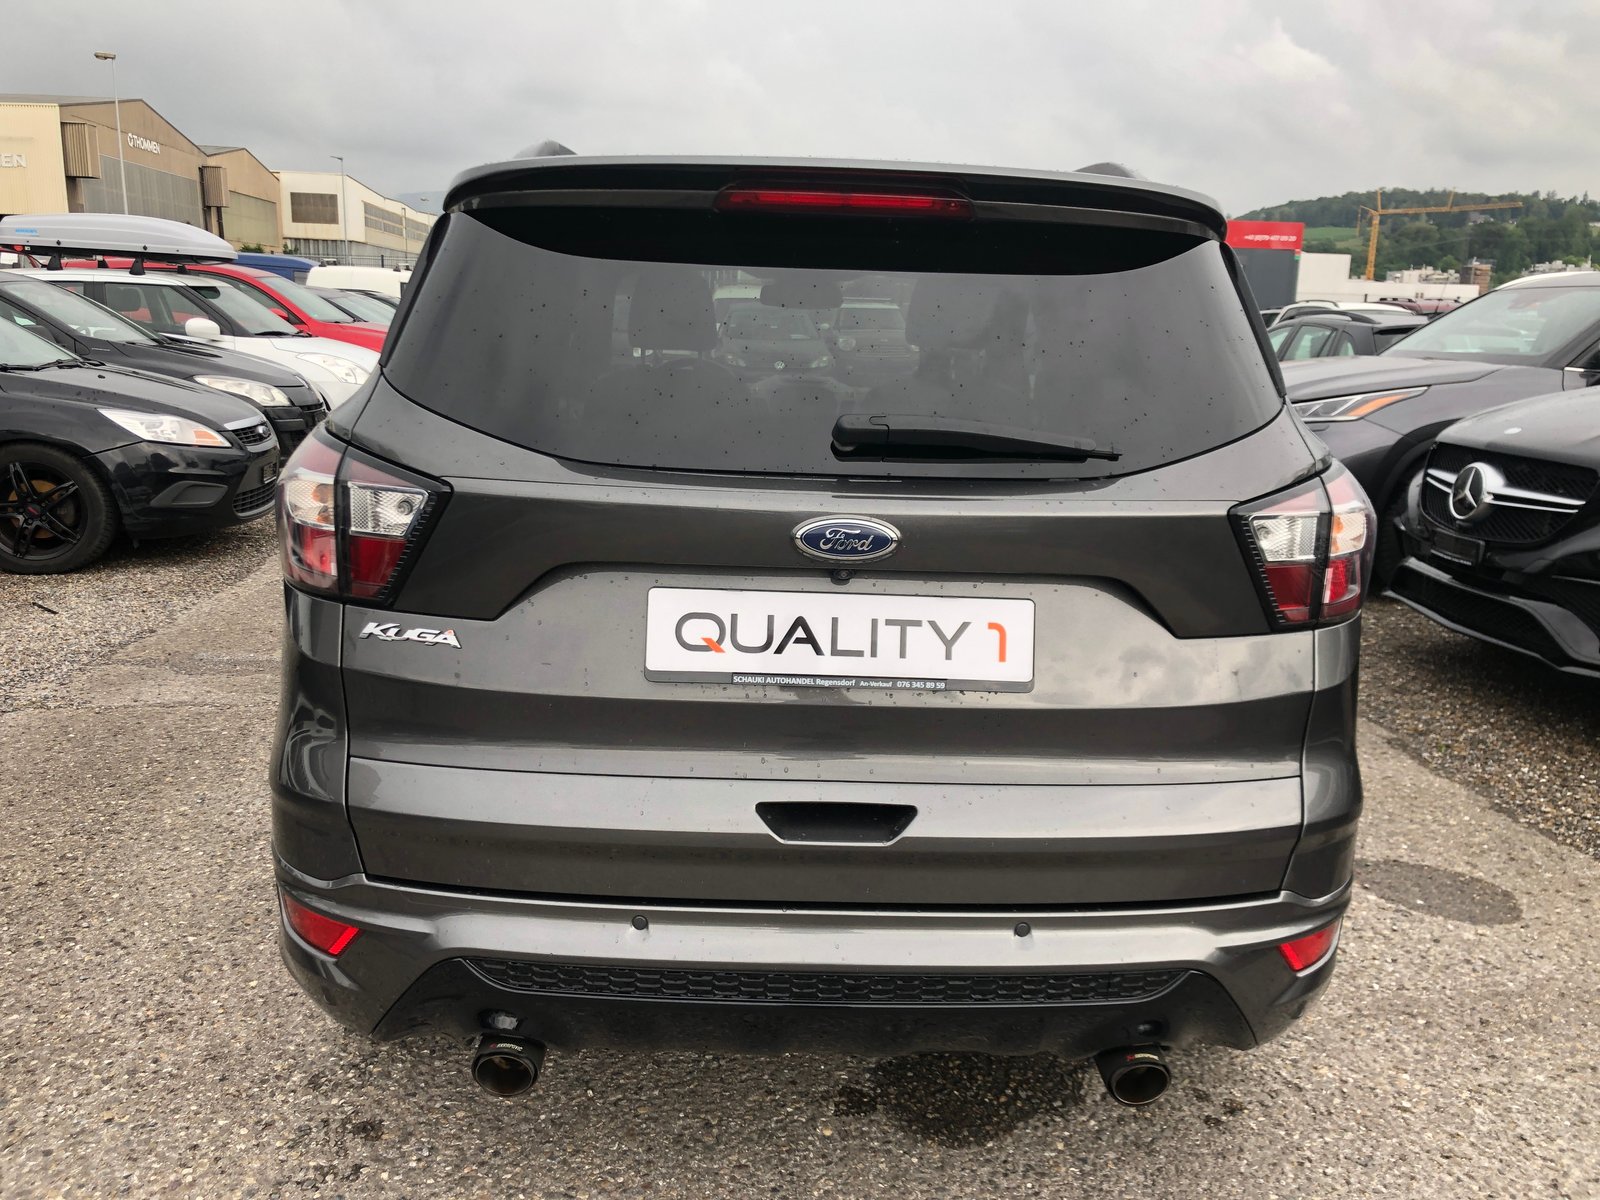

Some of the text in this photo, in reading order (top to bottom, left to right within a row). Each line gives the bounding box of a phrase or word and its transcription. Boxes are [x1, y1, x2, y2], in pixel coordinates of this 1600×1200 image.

[132, 134, 160, 154] THOMMEN
[0, 153, 26, 167] EN
[820, 527, 874, 552] Ford
[360, 622, 461, 648] KUGA
[674, 611, 972, 661] QUALITY
[733, 675, 946, 690] SCHAUKI AUTOHANDEL Regensdorf An-Verkauf 076 345 89 59
